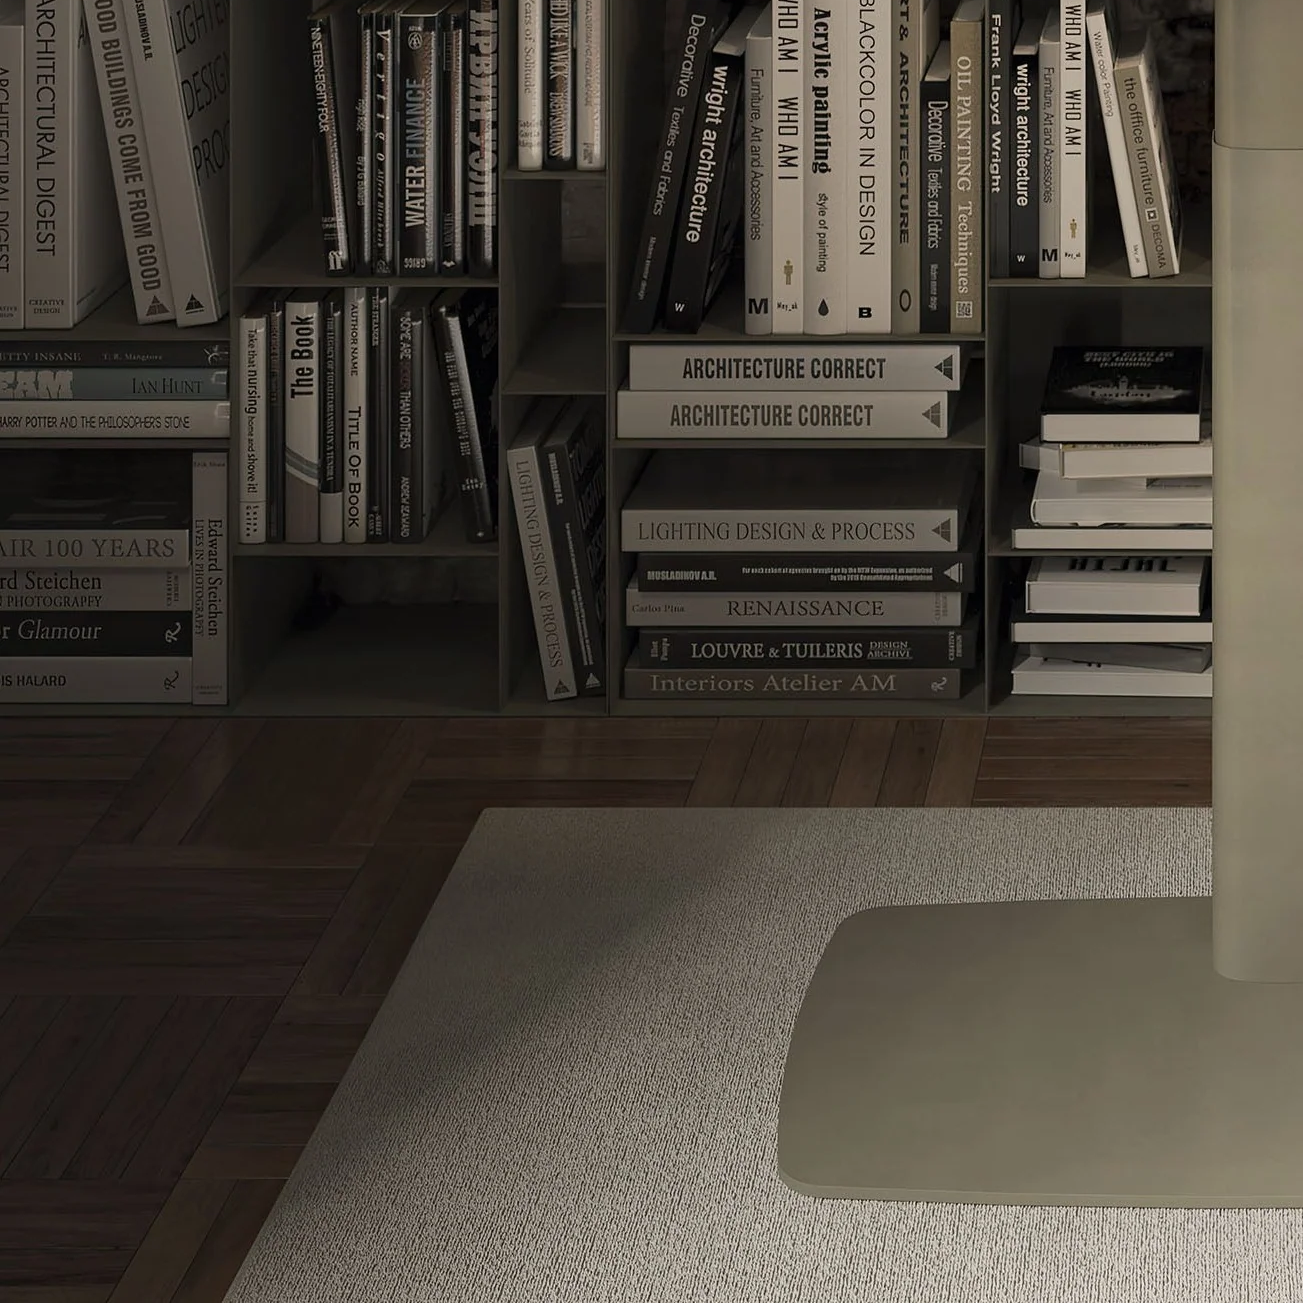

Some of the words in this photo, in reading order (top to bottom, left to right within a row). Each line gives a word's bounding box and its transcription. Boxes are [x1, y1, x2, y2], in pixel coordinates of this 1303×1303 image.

[778, 37, 798, 61] AM
[992, 14, 1001, 68] Frank
[705, 66, 728, 125] wright
[990, 75, 1001, 125] Lloyd
[778, 98, 798, 135] WHO
[778, 143, 798, 168] AM
[686, 131, 717, 243] architecture
[727, 601, 884, 616] RENAISSANCE
[650, 675, 753, 691] Interiors
[762, 675, 842, 691] Atelier
[850, 675, 896, 691] AM
